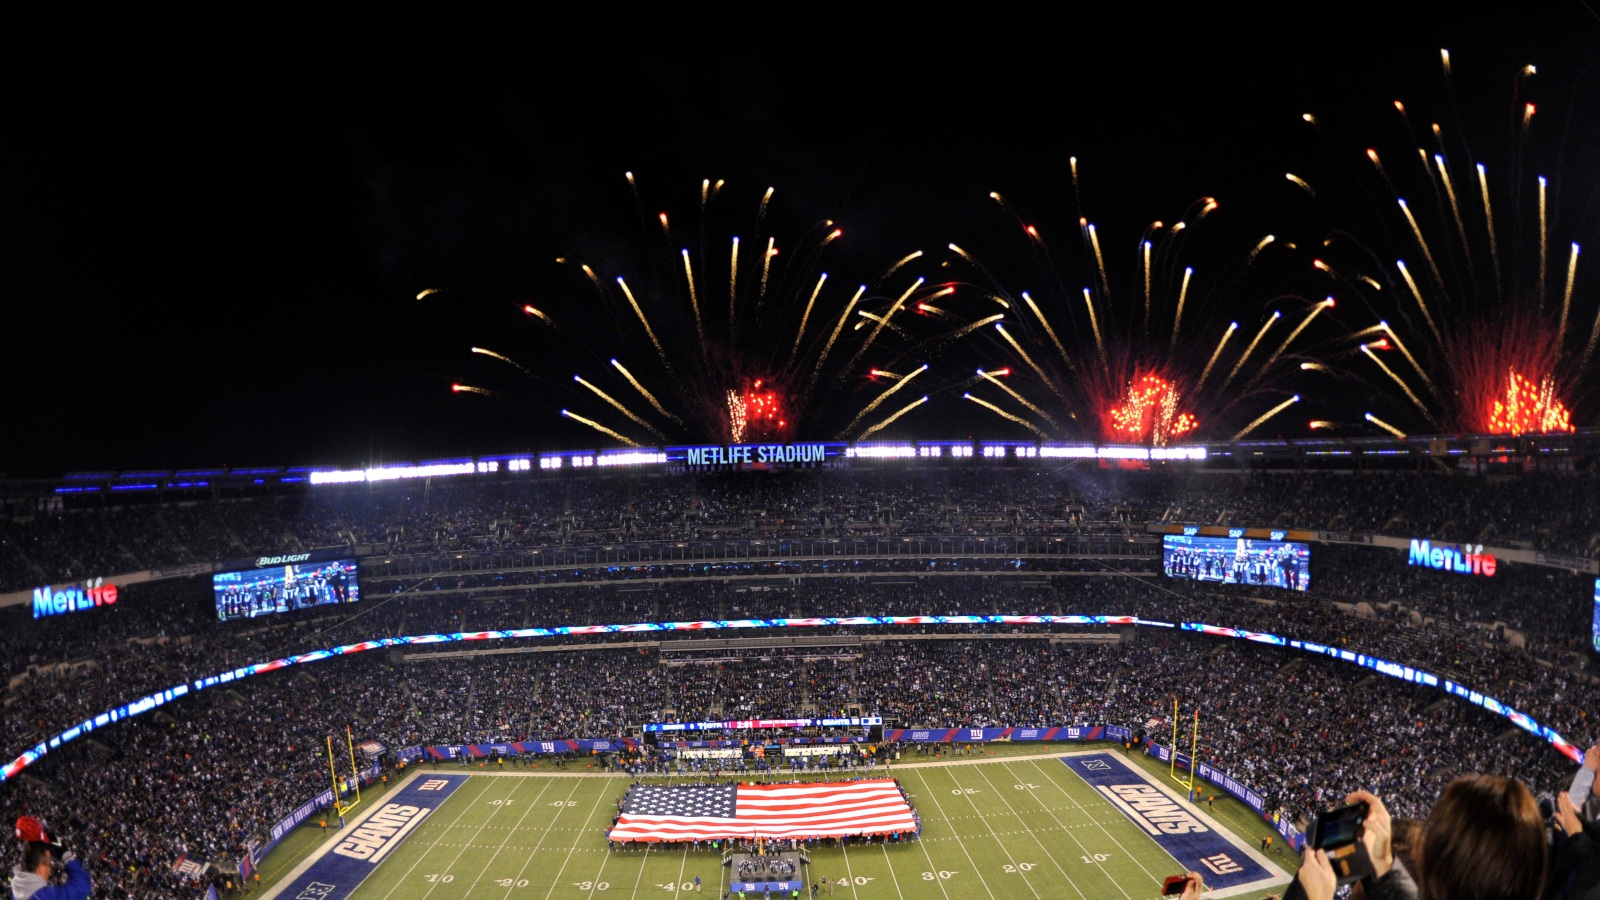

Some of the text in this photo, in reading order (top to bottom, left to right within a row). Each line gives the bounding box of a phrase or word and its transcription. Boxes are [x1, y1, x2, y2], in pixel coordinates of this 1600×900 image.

[687, 444, 825, 465] METLIFE STADIUM
[1183, 527, 1198, 536] SAP
[1229, 529, 1243, 538] SAP
[1270, 531, 1284, 540] SAP
[259, 553, 311, 566] BUD LIGHT
[1408, 539, 1497, 578] MetLife
[32, 577, 119, 620] MetLife
[1109, 784, 1209, 835] GIANTS
[333, 803, 420, 860] GIANTS
